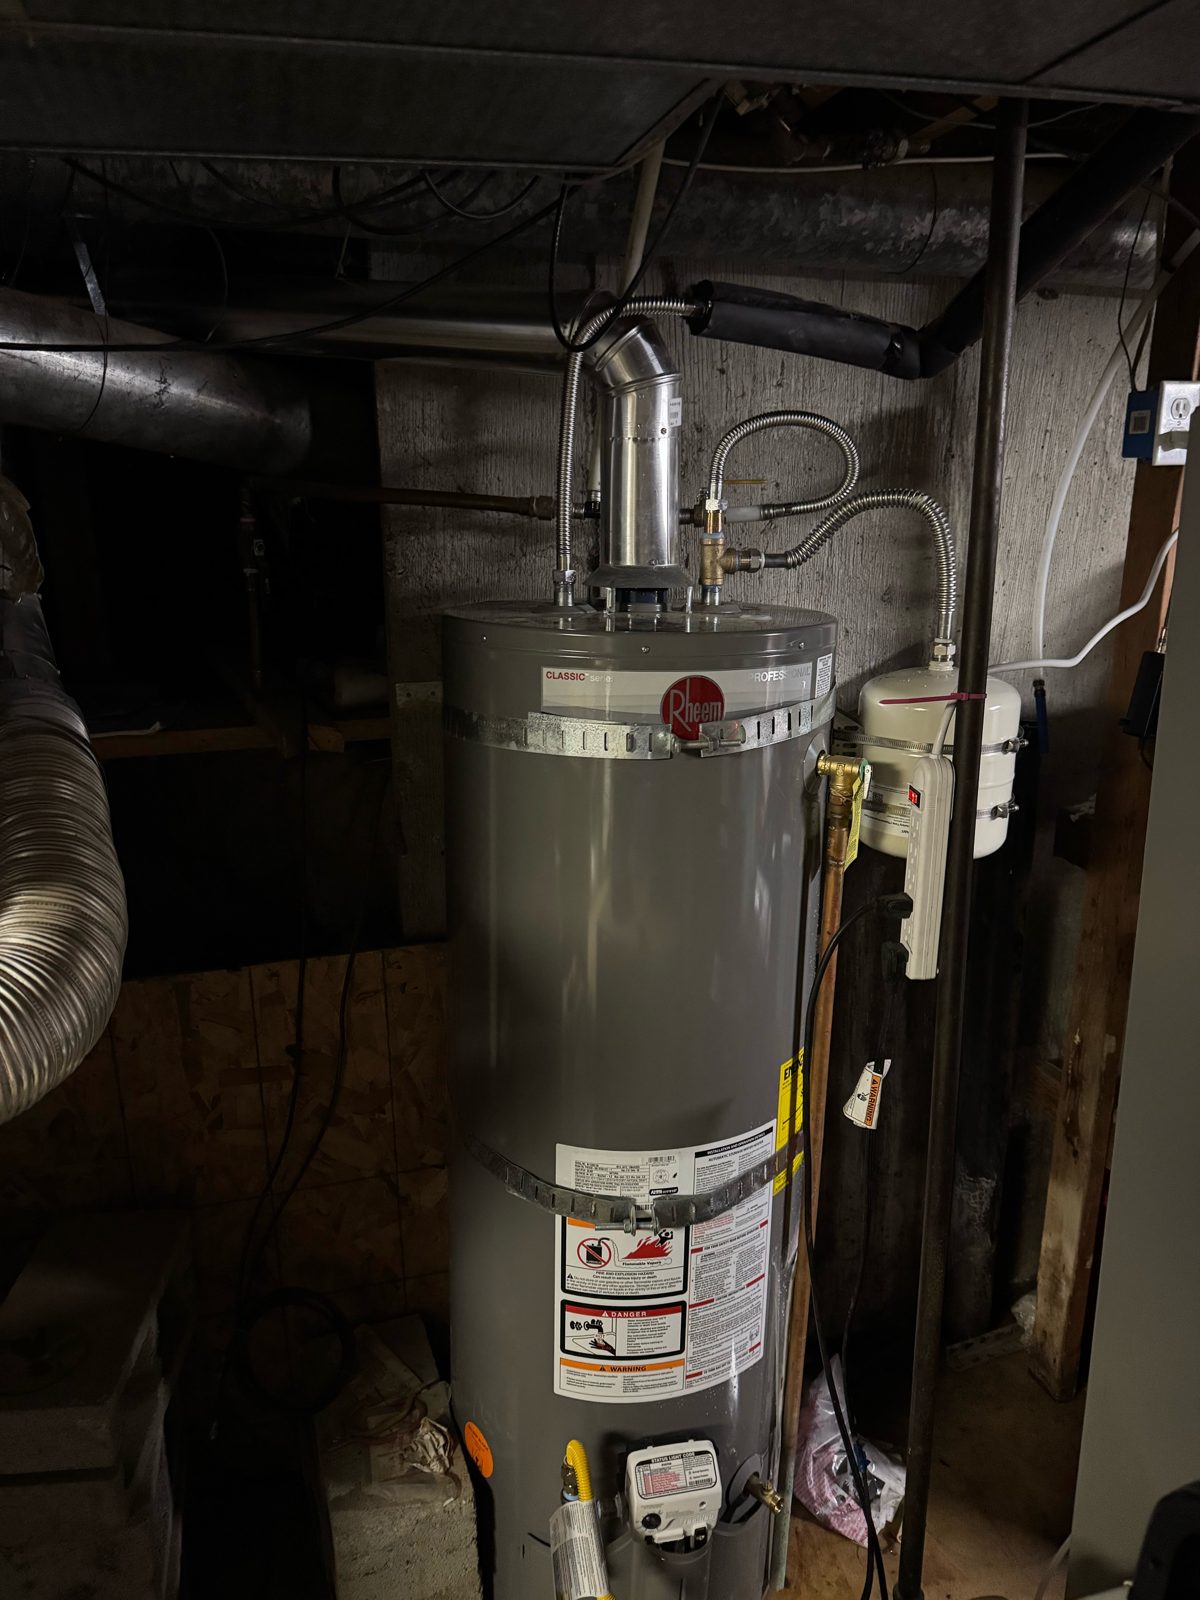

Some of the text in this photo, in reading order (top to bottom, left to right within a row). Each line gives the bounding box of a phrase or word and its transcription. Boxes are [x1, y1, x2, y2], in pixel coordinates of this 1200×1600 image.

[545, 671, 585, 681] CLASSIC
[669, 678, 722, 732] Rheem
[865, 1085, 878, 1122] WARNING
[610, 1365, 647, 1373] WARNING
[668, 1453, 682, 1461] LIGHT
